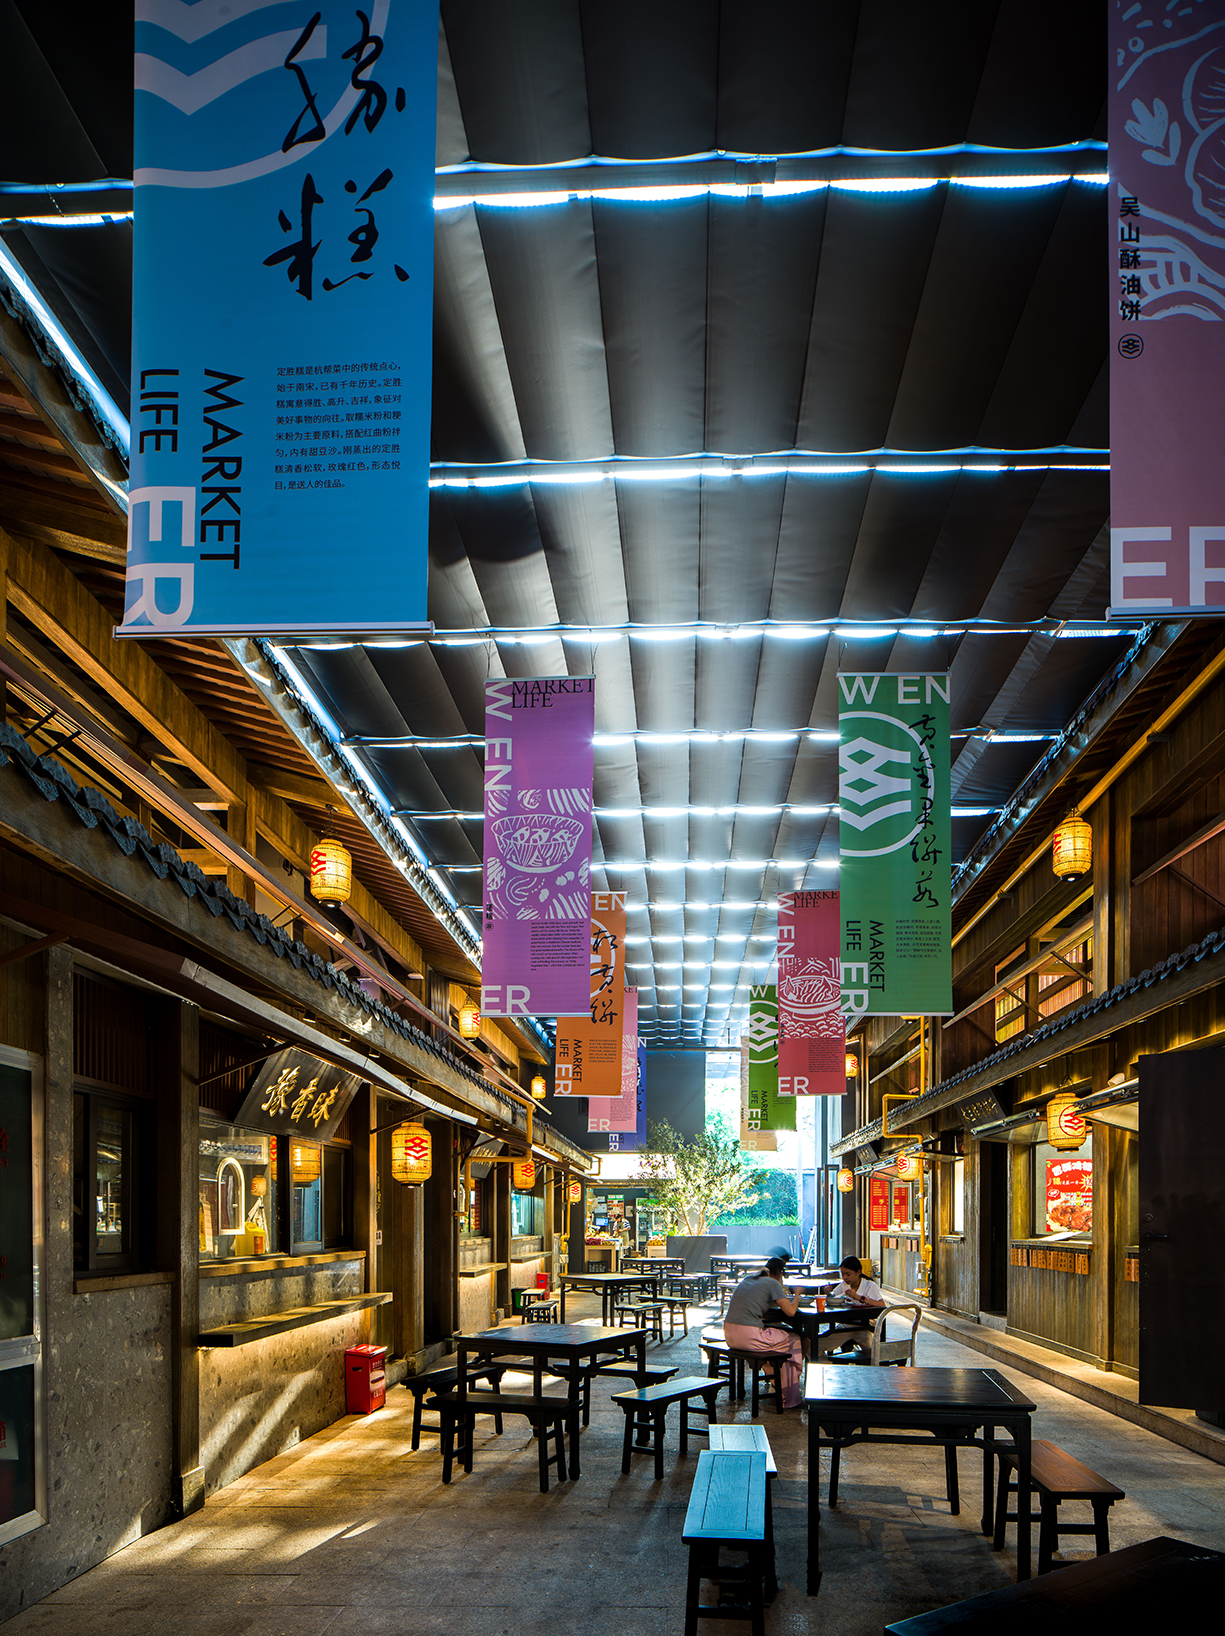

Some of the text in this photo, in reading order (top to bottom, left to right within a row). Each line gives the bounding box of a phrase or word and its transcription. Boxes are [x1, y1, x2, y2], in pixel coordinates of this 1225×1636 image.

[1119, 196, 1141, 321] 吴山酥油饼
[139, 368, 180, 454] LIFE
[200, 368, 246, 570] MARKET
[122, 485, 196, 627] ER
[511, 678, 593, 694] MARKET
[511, 691, 553, 709] LIFE
[794, 898, 820, 908] LIFE
[845, 920, 862, 951] LIFE
[868, 920, 885, 993] MARKET
[481, 984, 531, 1014] ER
[839, 961, 869, 1013] ER
[559, 1039, 569, 1058] LIFE
[571, 1039, 583, 1083] MARKET
[554, 1063, 573, 1096] ER
[777, 1076, 810, 1095] ER
[750, 1090, 759, 1105] LIFE
[760, 1090, 769, 1122] MARKET
[588, 1119, 611, 1132] ER
[747, 1108, 760, 1131] ER
[609, 1133, 619, 1152] ER
